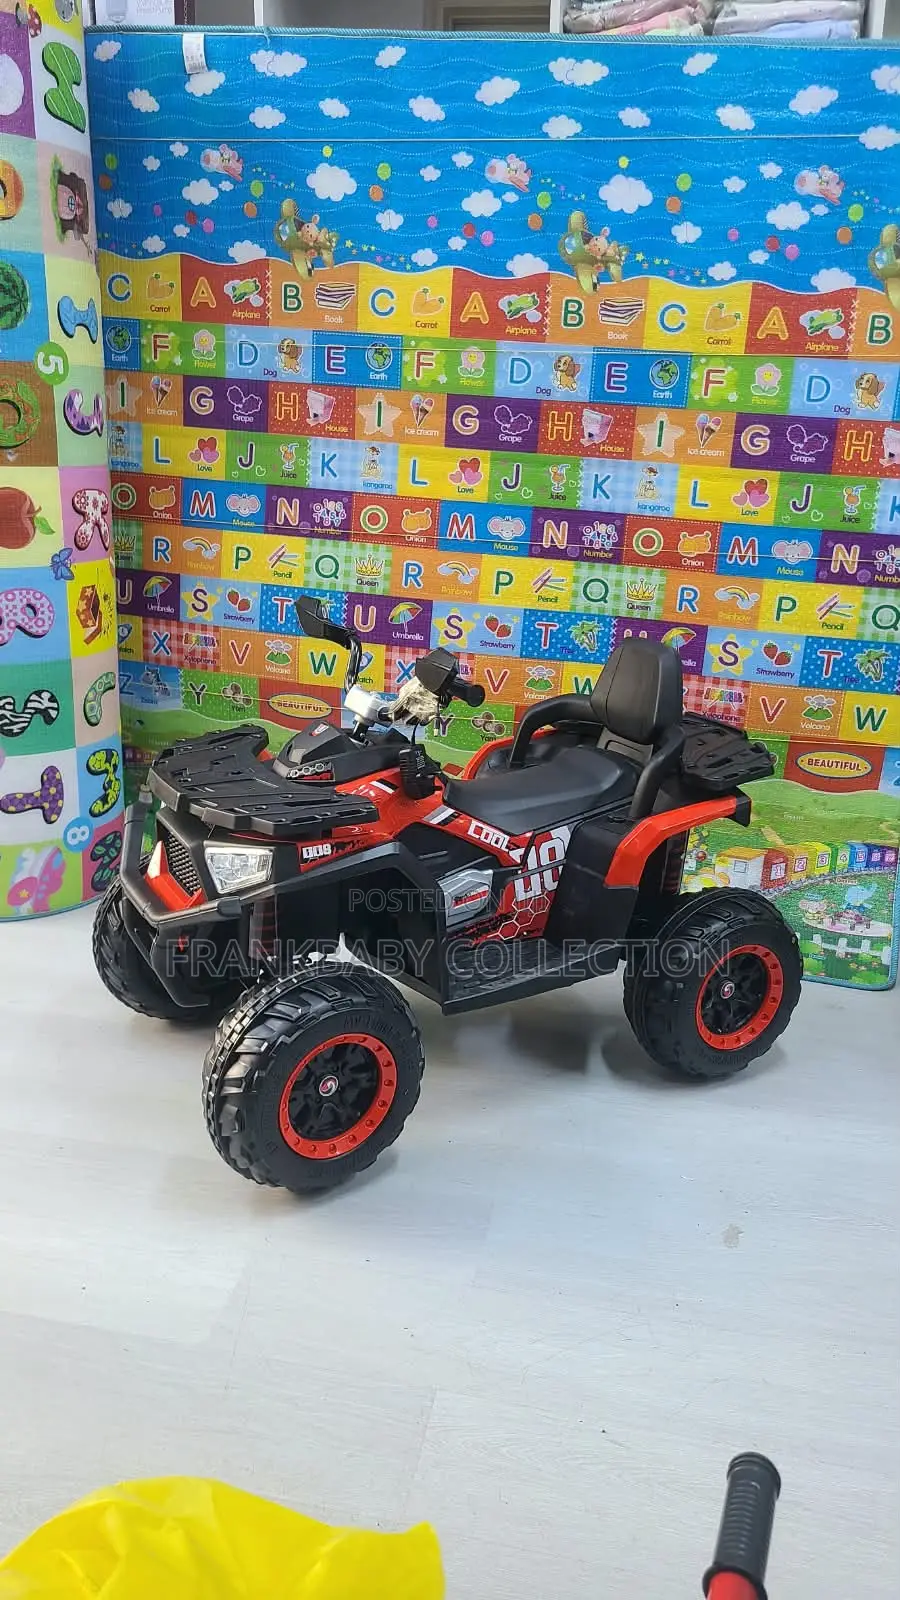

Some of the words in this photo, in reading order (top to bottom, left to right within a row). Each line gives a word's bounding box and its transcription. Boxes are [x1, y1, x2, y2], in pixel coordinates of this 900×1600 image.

[107, 273, 132, 302] C
[191, 276, 216, 308] A
[282, 281, 303, 313] B
[150, 304, 171, 313] Carrot
[232, 310, 260, 319] Airplane
[369, 287, 396, 318] C
[460, 292, 489, 324] A
[561, 297, 585, 329] B
[324, 314, 344, 324] Book
[415, 320, 439, 329] Carrot
[506, 326, 537, 336] Airplane
[658, 302, 687, 334] C
[757, 306, 789, 340] A
[866, 312, 893, 346] B
[151, 333, 170, 362] F
[608, 332, 628, 340] Book
[707, 336, 732, 346] Carrot
[805, 342, 839, 352] Airplane
[38, 352, 64, 376] 5
[111, 354, 128, 362] Earth
[237, 339, 259, 369] D
[326, 344, 346, 374] E
[414, 350, 434, 380] F
[264, 368, 277, 378] Dog
[370, 372, 388, 381] Earth
[509, 356, 532, 385] D
[605, 362, 628, 392] E
[702, 368, 726, 398] F
[190, 386, 215, 416] G
[536, 386, 552, 396] Dog
[652, 390, 673, 399] Earth
[806, 374, 831, 405] D
[146, 407, 156, 416] Ice
[156, 408, 178, 416] cream
[232, 414, 254, 423] Grape
[276, 391, 300, 421] H
[376, 400, 384, 429] I
[834, 404, 850, 415] Dog
[324, 424, 348, 433] House
[404, 428, 417, 436] Ice
[418, 429, 440, 437] cream
[452, 404, 480, 435] G
[548, 410, 573, 442] H
[498, 434, 522, 444] Grape
[656, 419, 664, 449] I
[741, 424, 770, 456] G
[843, 430, 874, 462] H
[154, 436, 172, 464] L
[237, 442, 256, 470] J
[600, 445, 625, 454] House
[688, 448, 699, 456] Ice
[700, 449, 725, 457] cream
[790, 454, 816, 464] Grape
[197, 464, 212, 472] Love
[280, 470, 298, 479] Juice
[320, 451, 338, 478] K
[411, 458, 430, 486] L
[502, 462, 522, 492] J
[112, 482, 137, 510] O
[362, 480, 393, 490] kangaroo
[458, 486, 474, 494] Love
[548, 492, 567, 501] Juice
[592, 472, 612, 500] K
[690, 478, 711, 508] L
[190, 490, 216, 518] M
[276, 498, 300, 526] N
[637, 502, 671, 512] kangaroo
[790, 484, 814, 514] J
[152, 510, 172, 519] Onion
[232, 519, 256, 527] Mouse
[360, 504, 388, 534] O
[741, 508, 759, 517] Love
[840, 516, 861, 524] Juice
[405, 534, 426, 544] Onion
[446, 512, 476, 541] M
[542, 520, 568, 549] N
[152, 536, 172, 564] R
[494, 542, 518, 552] Mouse
[583, 550, 614, 559] Number
[632, 528, 664, 557] O
[726, 536, 759, 566] M
[234, 544, 252, 570] P
[314, 554, 340, 580] Q
[681, 558, 704, 567] Onion
[830, 543, 861, 574] N
[272, 570, 292, 578] Pencil
[356, 578, 380, 587] Queen
[402, 560, 424, 588] R
[494, 570, 514, 596] P
[776, 566, 804, 576] Mouse
[116, 578, 133, 604] U
[191, 588, 209, 613] S
[538, 596, 558, 604] Pencil
[582, 577, 610, 604] Q
[676, 584, 700, 614] R
[147, 602, 175, 614] Umbrella
[223, 613, 256, 624] Strawberry
[272, 596, 294, 624] T
[354, 604, 376, 632] U
[626, 602, 652, 612] Queen
[774, 594, 798, 624] P
[871, 604, 900, 632] Q
[392, 631, 424, 641] Umbrella
[444, 614, 464, 640] S
[534, 622, 559, 650] T
[821, 622, 844, 631] Pencil
[151, 630, 172, 656] X
[229, 639, 251, 666] V
[480, 640, 516, 650] Strawberry
[718, 640, 740, 667] S
[184, 655, 217, 666] Xylophone
[264, 664, 292, 674] Volcano
[309, 651, 338, 678] W
[756, 668, 795, 678] Strawberry
[817, 649, 844, 678] T
[188, 682, 207, 706] Y
[484, 668, 510, 695] V
[760, 696, 786, 724] V
[854, 704, 888, 732] W
[480, 734, 496, 742] Yam
[800, 722, 830, 731] Volcano
[808, 758, 862, 772] BEAUTIFUL
[468, 819, 511, 852] COOL
